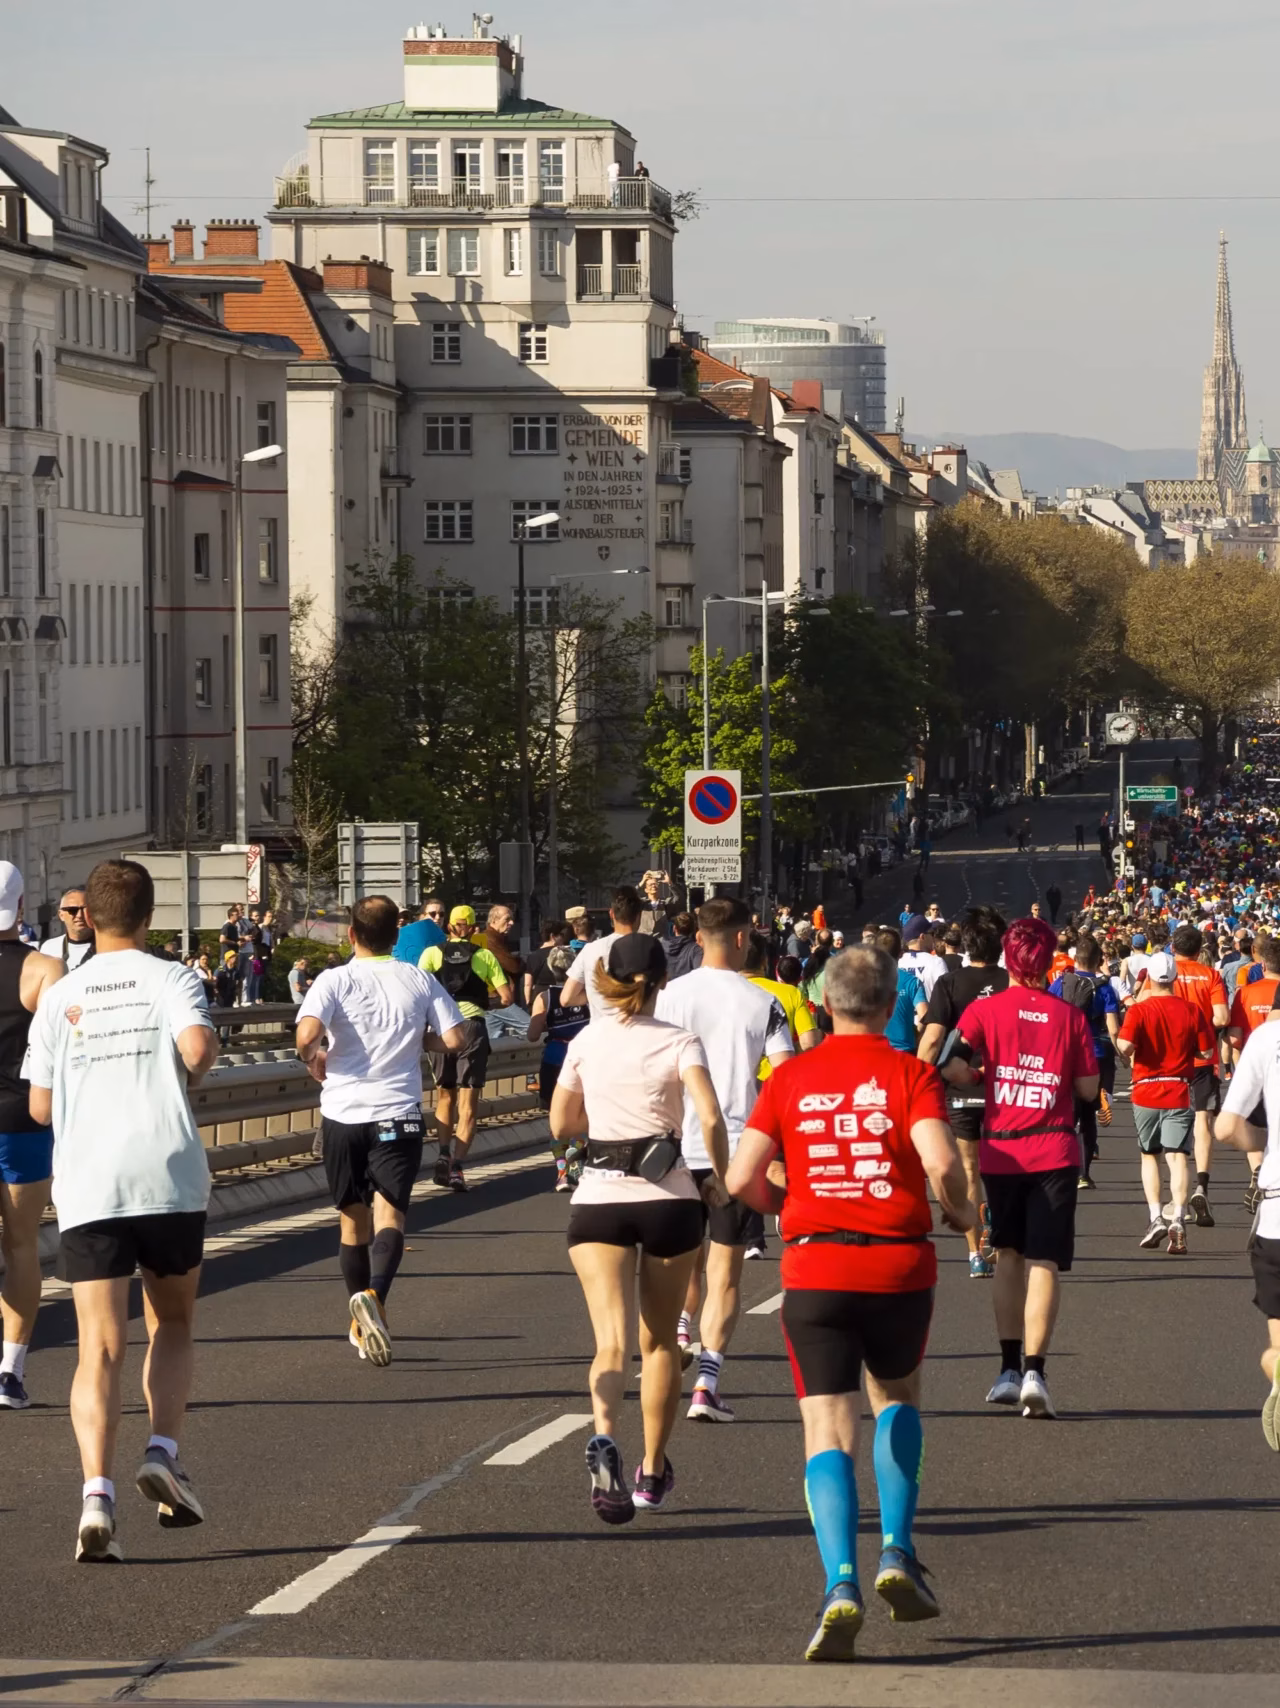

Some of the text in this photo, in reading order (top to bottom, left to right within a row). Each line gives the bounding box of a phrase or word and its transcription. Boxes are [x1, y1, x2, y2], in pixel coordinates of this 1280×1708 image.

[563, 414, 643, 426] ERBAUT VON DER
[564, 429, 643, 446] GEMEINDE
[586, 450, 624, 467] WIEN
[564, 471, 643, 481] IN DEN JAHREN
[575, 485, 633, 496] 1924-1925
[564, 500, 643, 510] AUS DEN MITTELN
[593, 514, 614, 524] DER
[562, 528, 645, 539] WOHNBAUSTEUER
[687, 835, 739, 850] Kurzparkzone
[85, 980, 137, 995] FINISHER
[1018, 1009, 1048, 1023] NEOS
[1018, 1053, 1045, 1070] WIR
[996, 1065, 1061, 1086] BEWEGEN
[994, 1081, 1057, 1110] WIEN
[403, 1123, 420, 1133] 563
